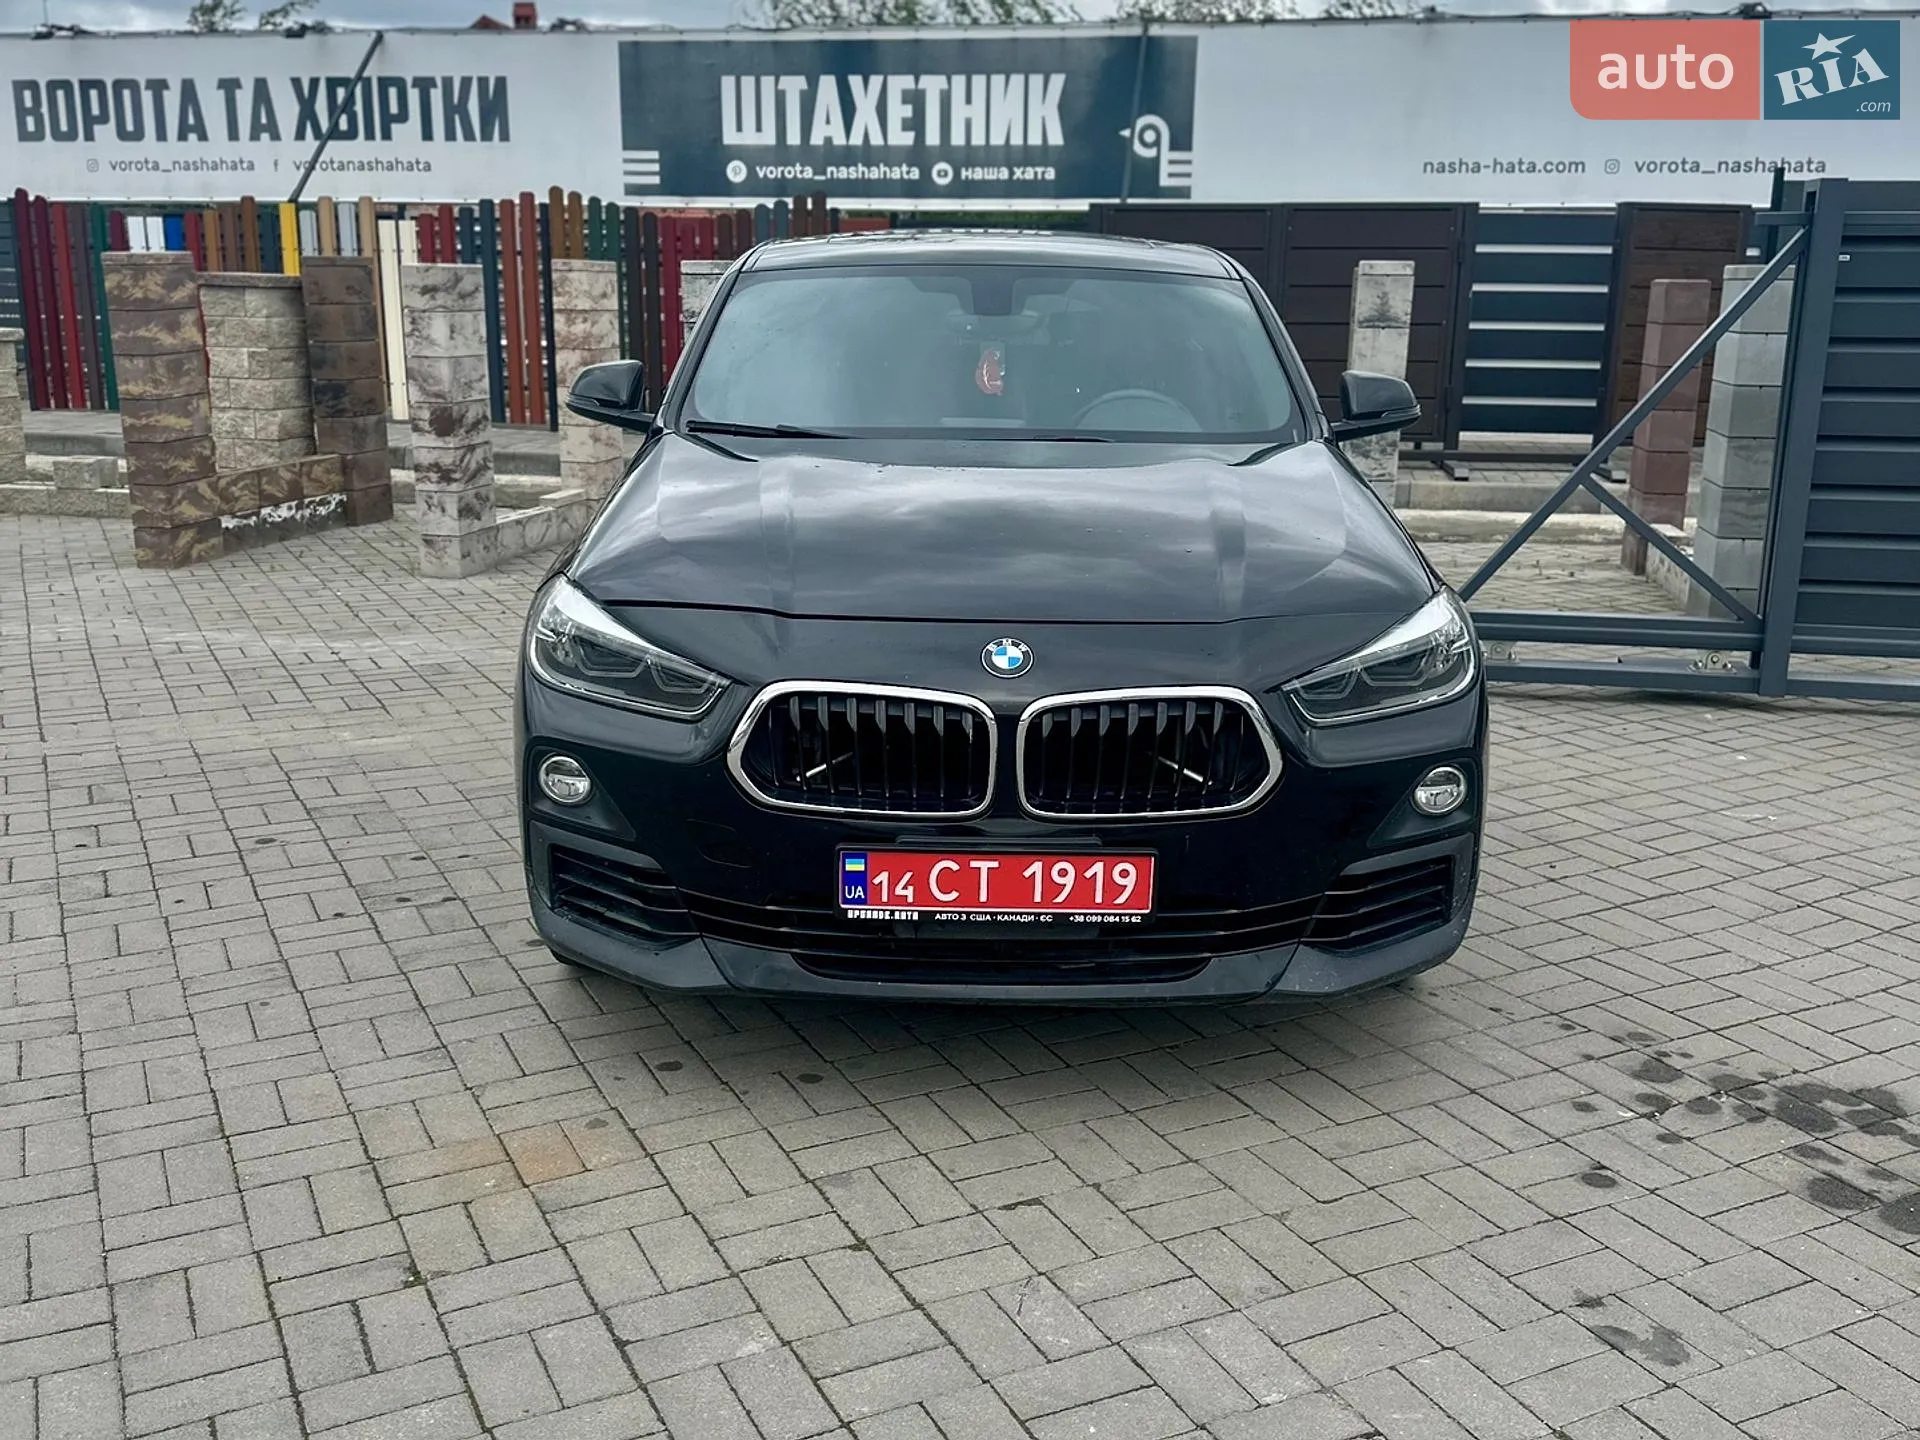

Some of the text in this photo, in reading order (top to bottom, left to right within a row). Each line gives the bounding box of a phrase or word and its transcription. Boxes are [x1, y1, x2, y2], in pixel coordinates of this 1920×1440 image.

[12, 75, 511, 142] ВОРОТА ТА ХВІРТКИ
[720, 73, 1066, 146] ШТАХЕТНИК
[109, 157, 255, 173] vorota_nashahata
[293, 157, 432, 173] vootanashahata
[756, 162, 920, 181] vorota_nashahata
[961, 165, 1056, 181] наша хата
[1422, 157, 1587, 175] nasha-hata.com
[1634, 156, 1827, 175] vorota_nashahata
[872, 871, 914, 903] 14
[1022, 860, 1138, 905] 1919
[845, 885, 865, 899] UA
[997, 914, 1035, 922] КАНАДИ
